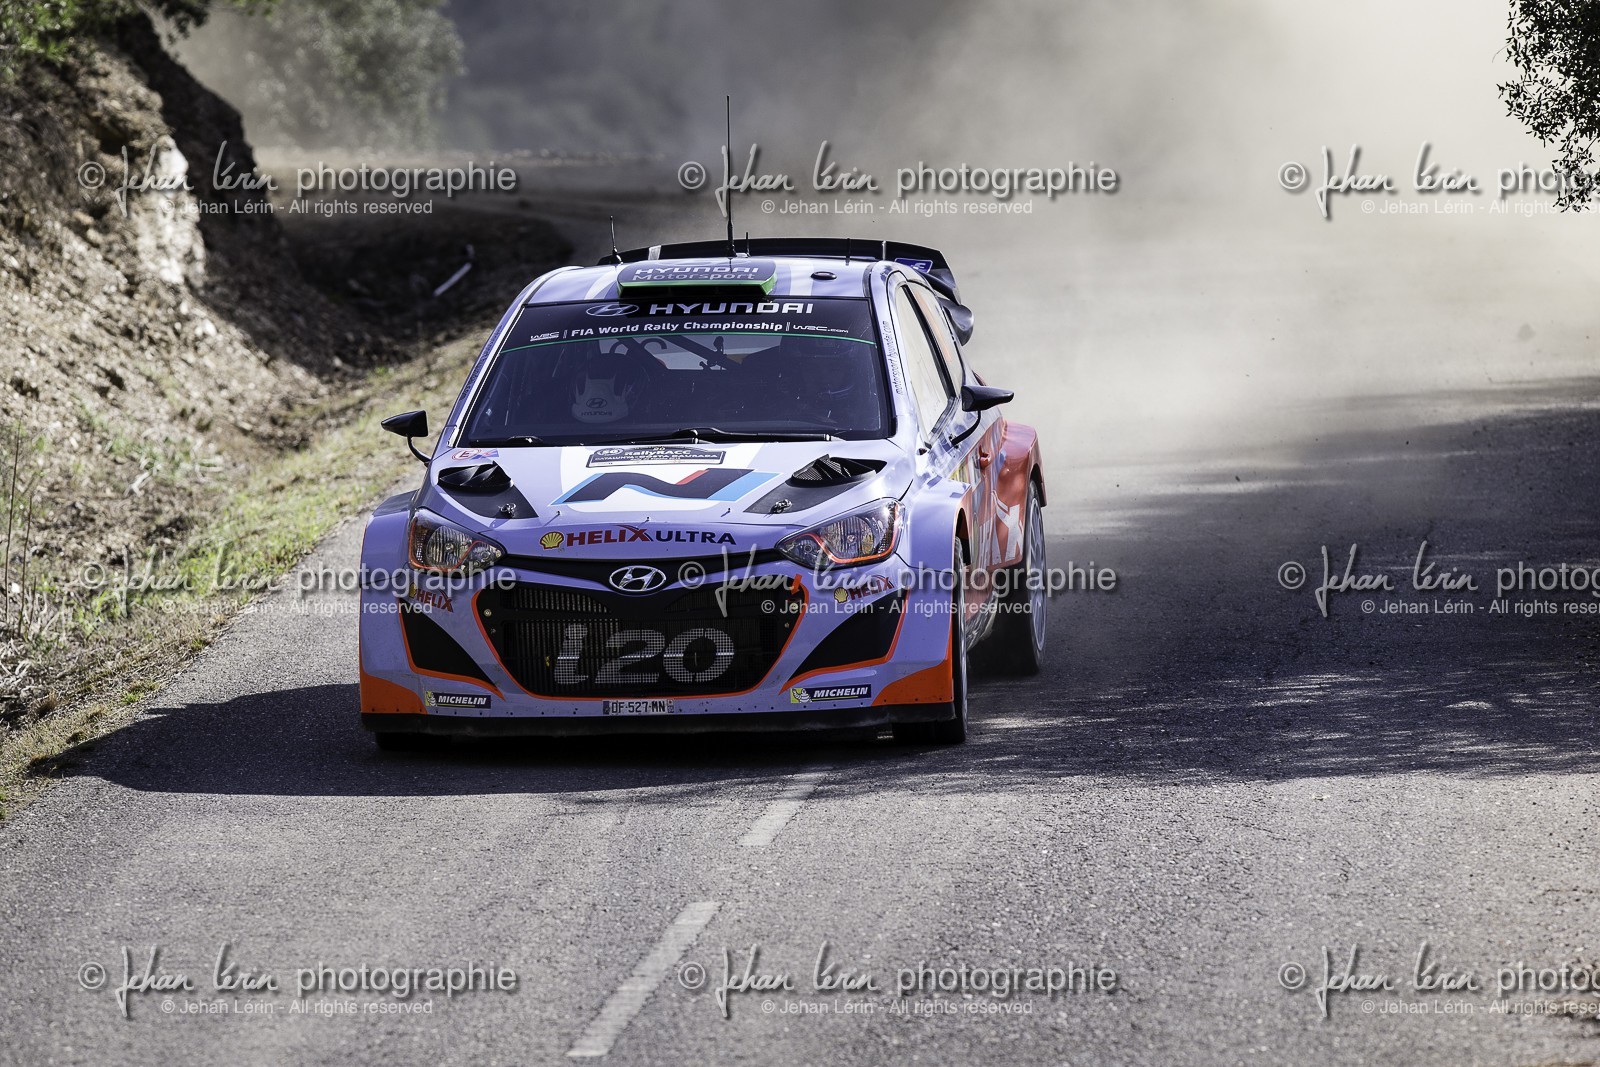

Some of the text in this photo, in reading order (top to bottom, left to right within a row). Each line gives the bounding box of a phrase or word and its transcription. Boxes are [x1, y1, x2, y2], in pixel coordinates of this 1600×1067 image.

[633, 273, 756, 281] Motorsport
[635, 266, 759, 274] HYUNDAI
[649, 302, 814, 315] HYUNDAI
[571, 328, 594, 337] FIA
[599, 323, 640, 334] World
[643, 322, 680, 332] Rally
[683, 321, 783, 331] Championship
[566, 525, 737, 547] HELIX ULTRA
[850, 575, 895, 601] HELIX
[416, 588, 454, 613] HELIX
[553, 624, 735, 685] i20
[813, 686, 869, 698] MICHELIN
[438, 695, 487, 705] MICHELIN
